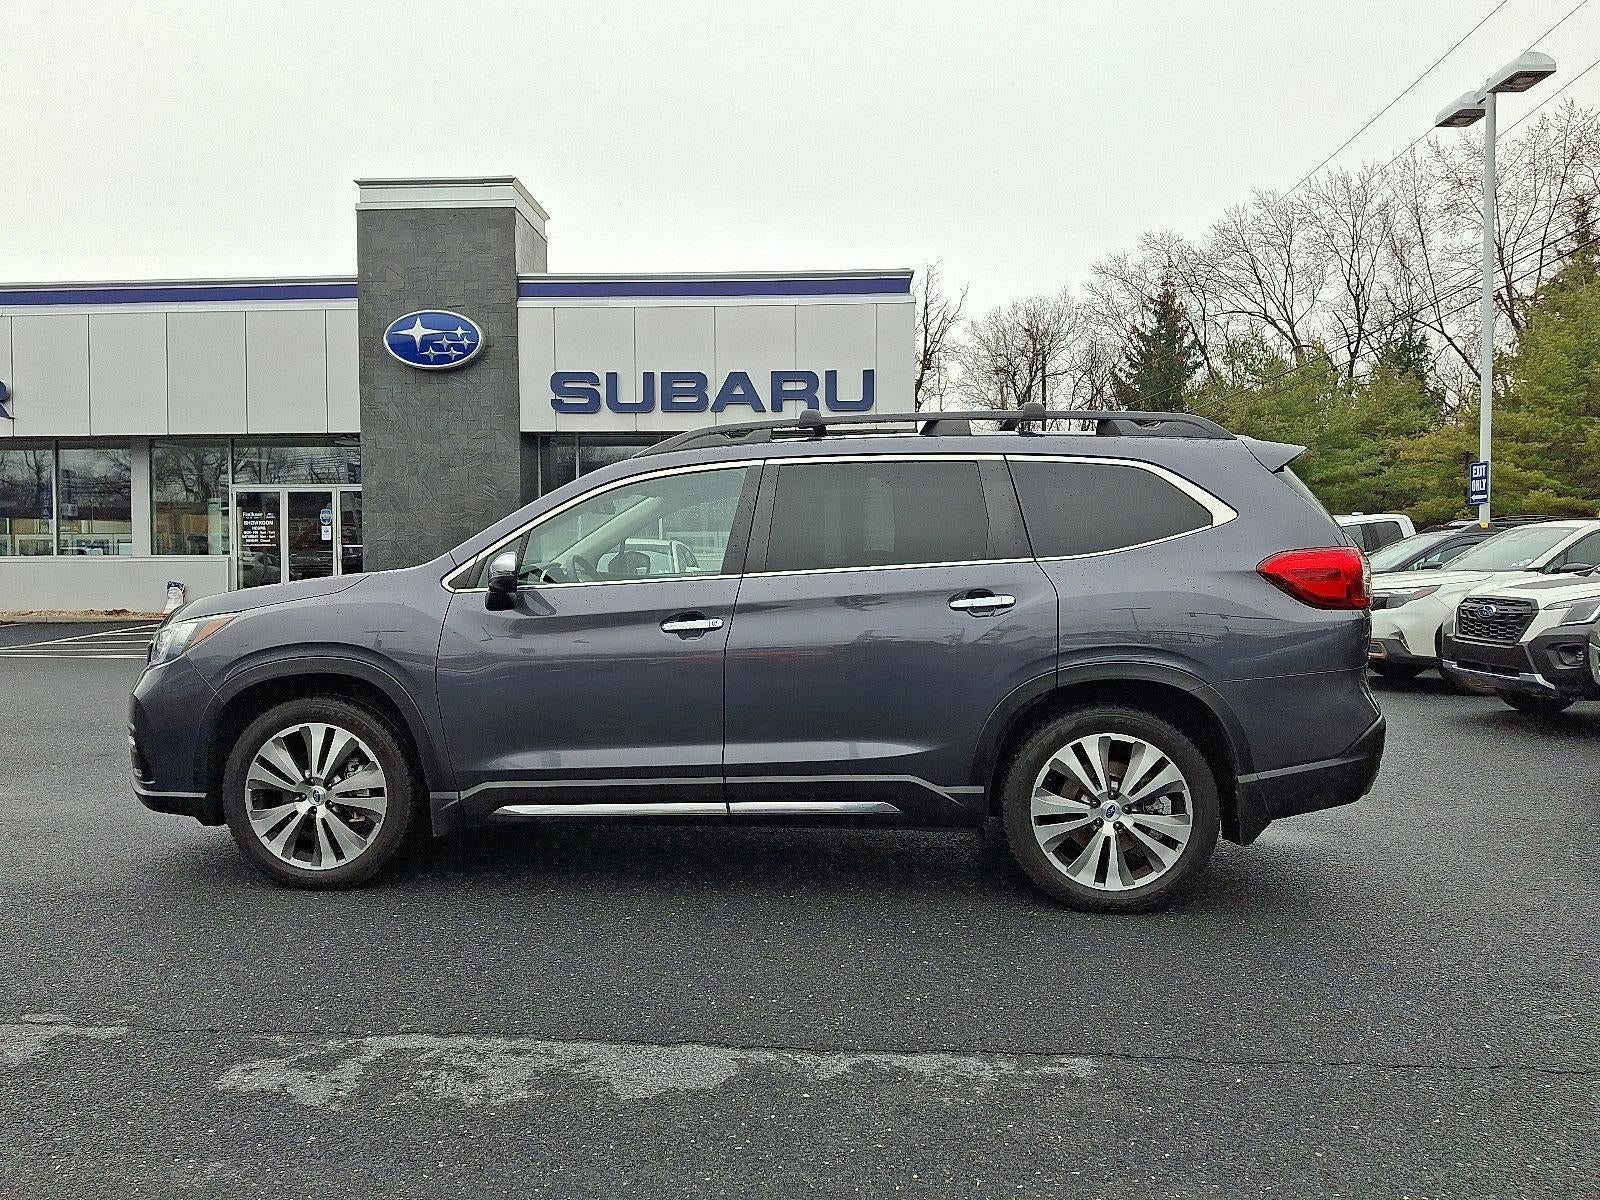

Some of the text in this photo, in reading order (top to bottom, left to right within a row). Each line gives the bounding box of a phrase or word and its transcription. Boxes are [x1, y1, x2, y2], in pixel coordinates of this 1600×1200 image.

[550, 369, 874, 414] SUBARU
[1472, 465, 1486, 477] EXIT
[1472, 479, 1486, 491] ONLY
